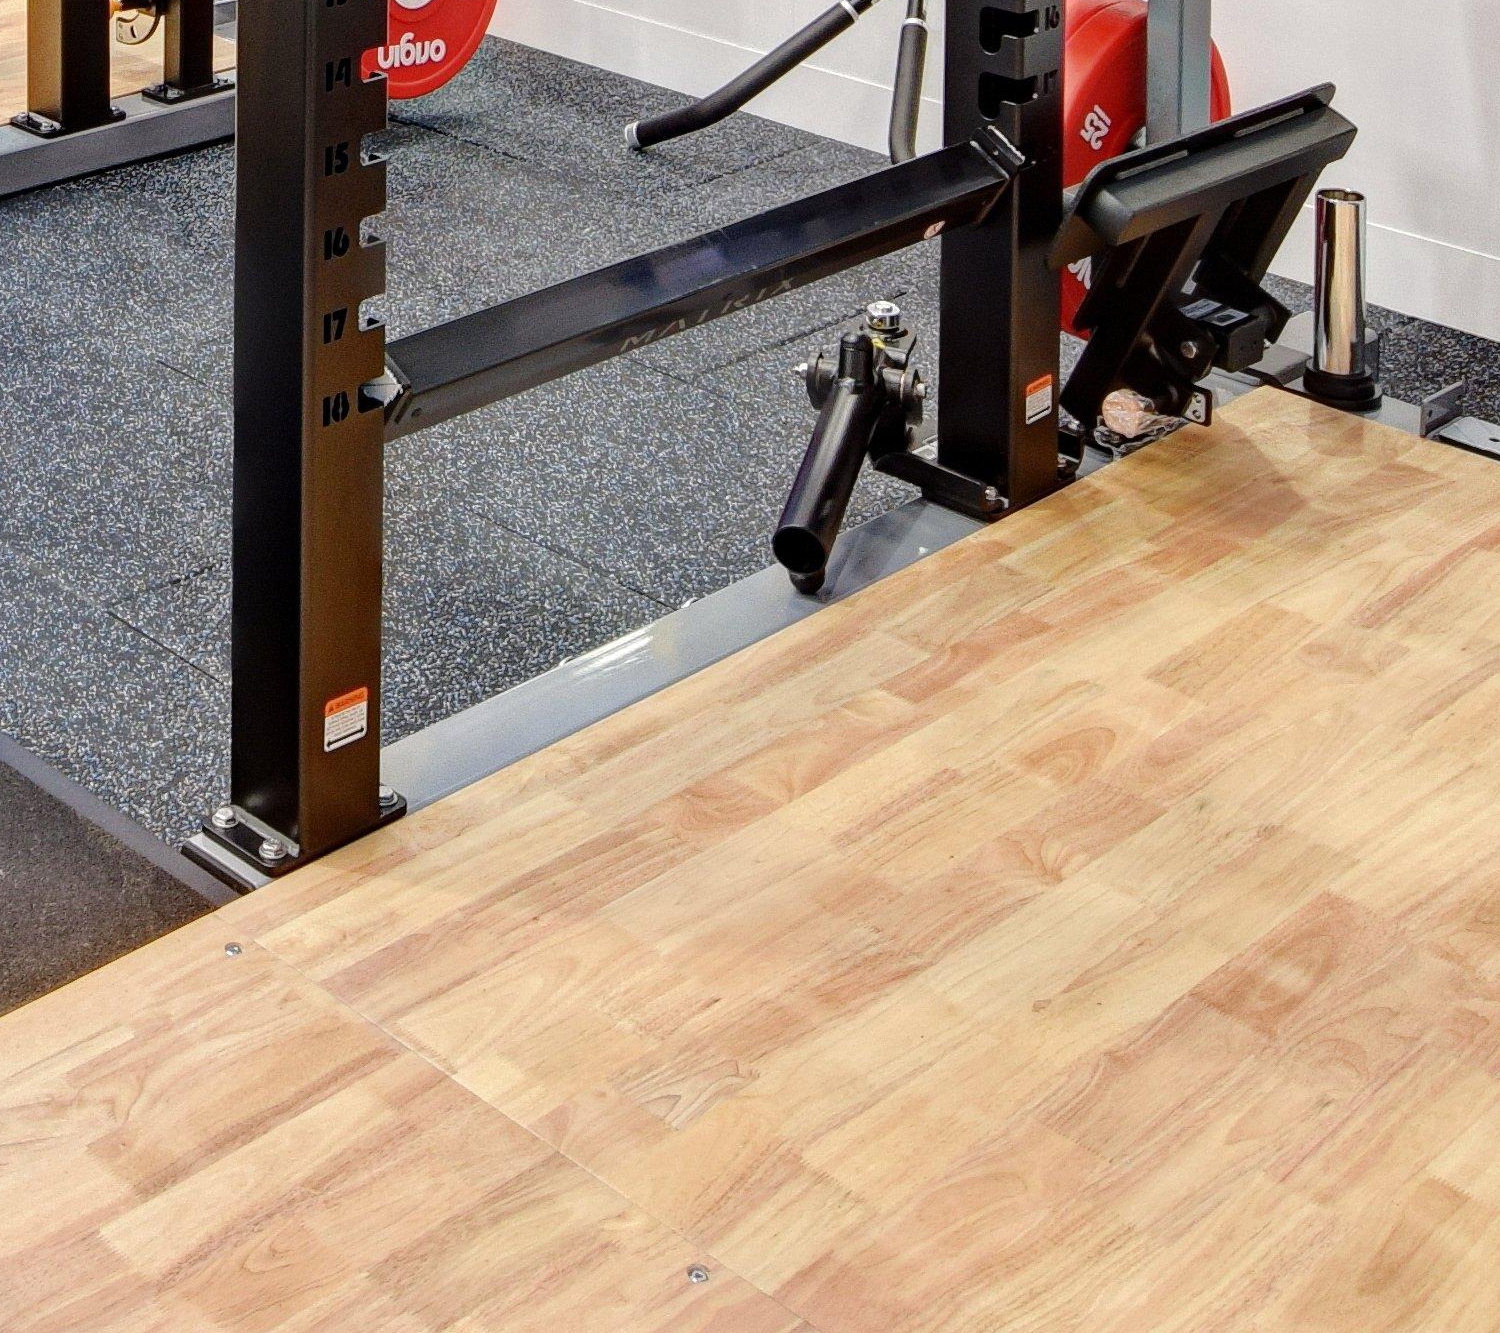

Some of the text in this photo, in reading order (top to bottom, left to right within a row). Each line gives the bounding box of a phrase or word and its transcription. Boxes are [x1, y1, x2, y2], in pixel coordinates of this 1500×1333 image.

[377, 32, 447, 70] origin
[325, 57, 351, 92] 14
[324, 141, 348, 176] 15
[323, 227, 350, 261] 16
[323, 309, 348, 345] 17
[322, 391, 350, 427] 18
